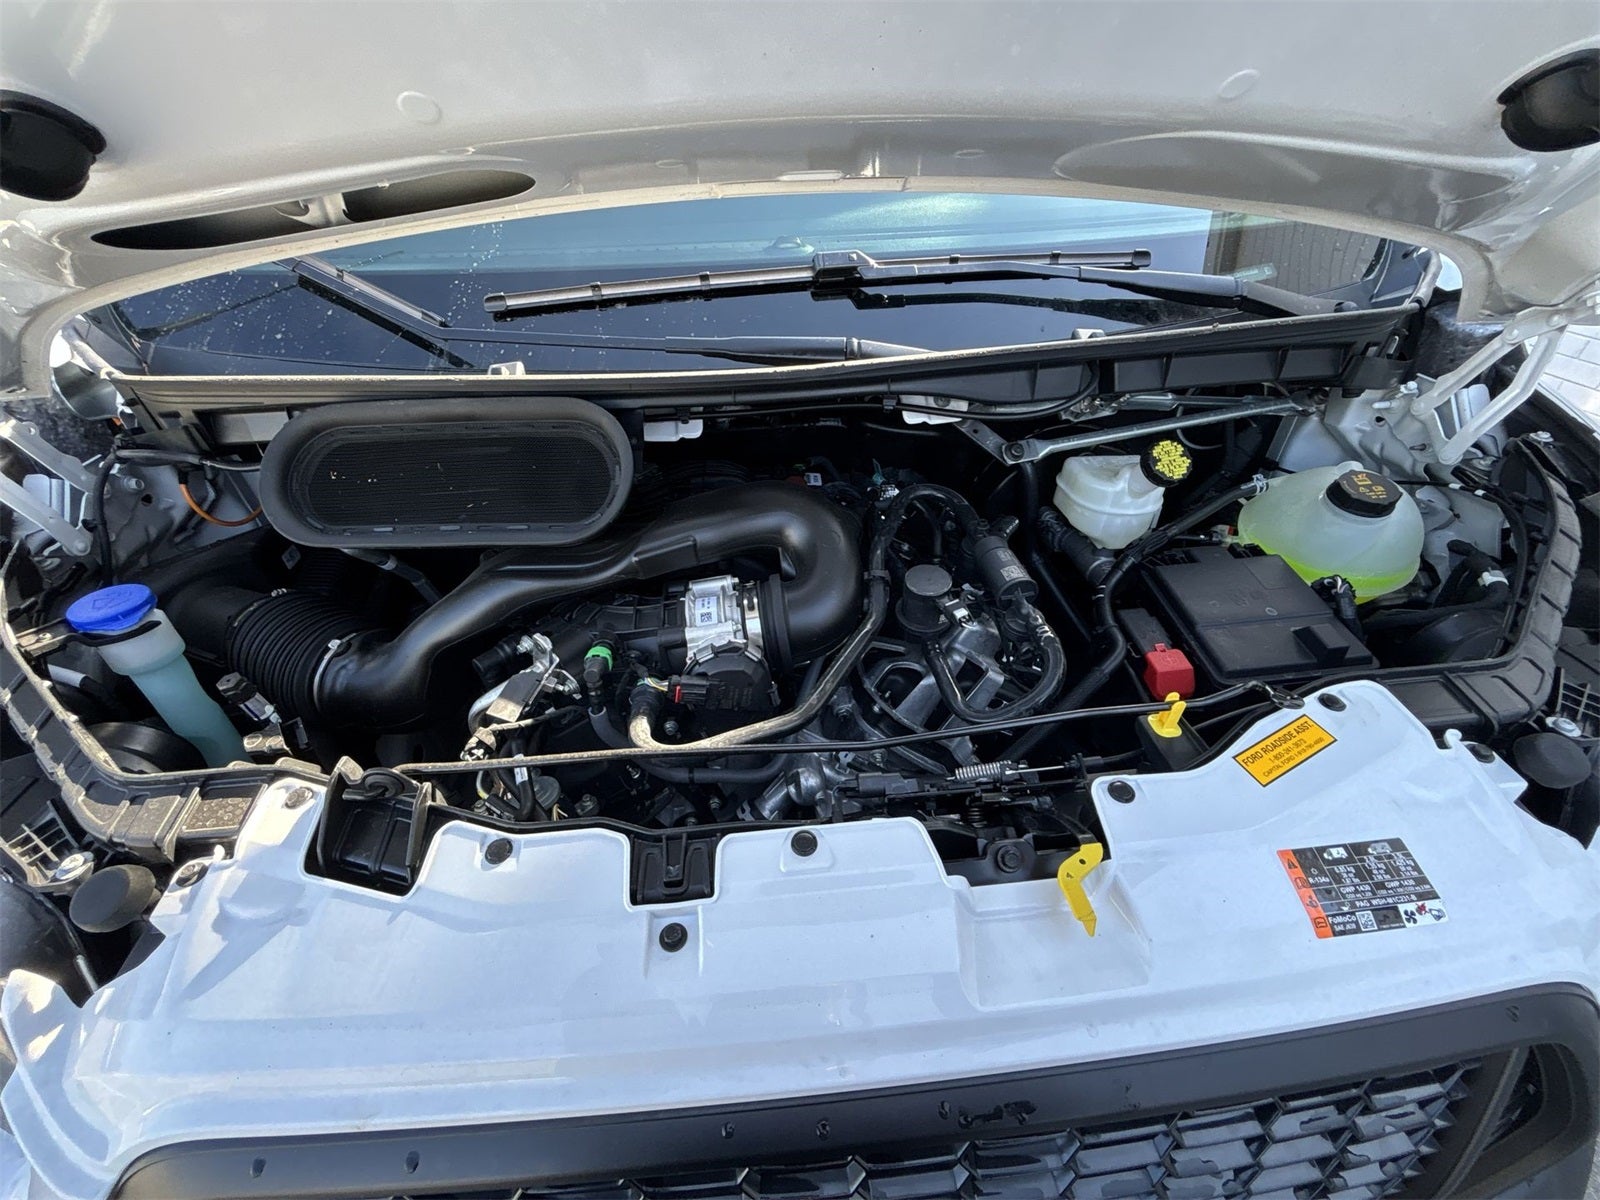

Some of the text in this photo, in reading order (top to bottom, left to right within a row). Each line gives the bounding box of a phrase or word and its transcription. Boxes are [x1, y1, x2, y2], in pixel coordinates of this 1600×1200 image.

[1242, 751, 1263, 767] FORD
[1262, 731, 1297, 755] ROADSIDE
[1340, 886, 1355, 894] GWP
[1328, 915, 1356, 924] FoMoCo
